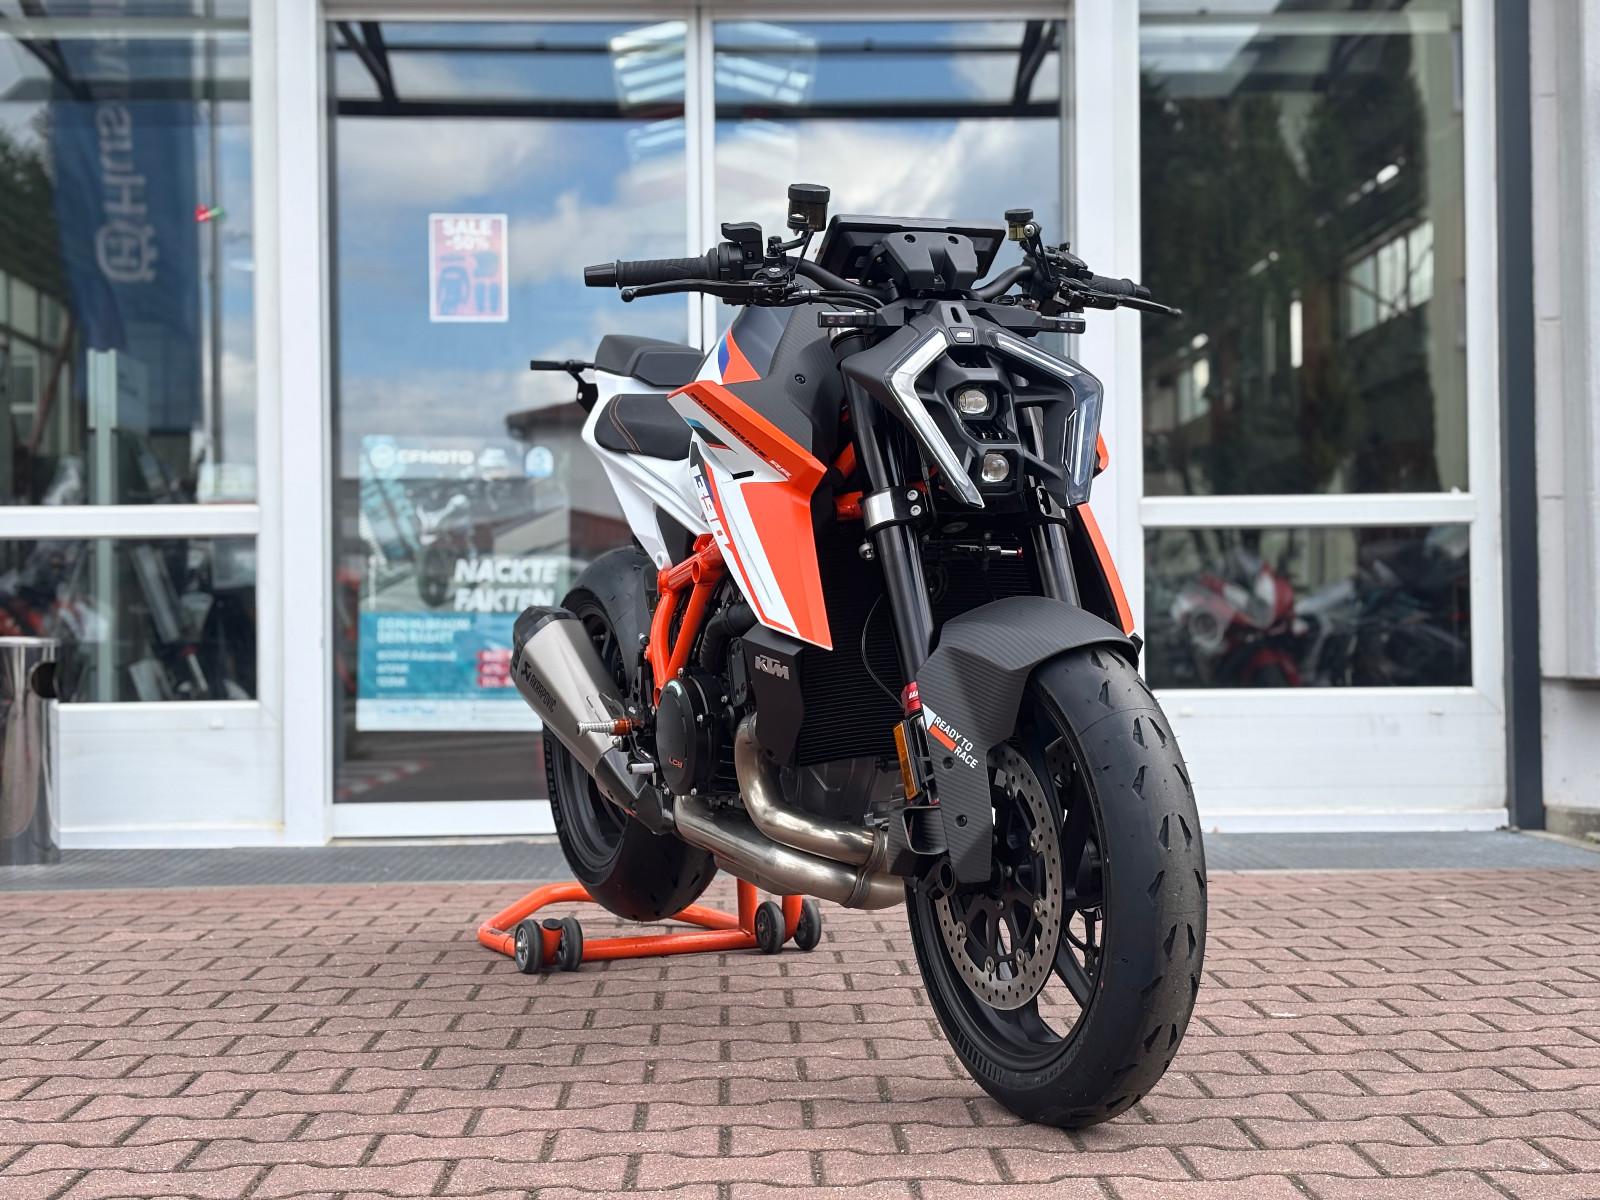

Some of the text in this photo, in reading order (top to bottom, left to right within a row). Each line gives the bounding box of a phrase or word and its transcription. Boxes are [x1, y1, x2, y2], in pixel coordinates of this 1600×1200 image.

[442, 218, 493, 236] SALE
[454, 558, 559, 583] NACKTE
[454, 587, 555, 612] FAKTEN
[754, 654, 790, 680] KTM
[934, 716, 974, 752] READY TO
[954, 745, 979, 769] RACE
